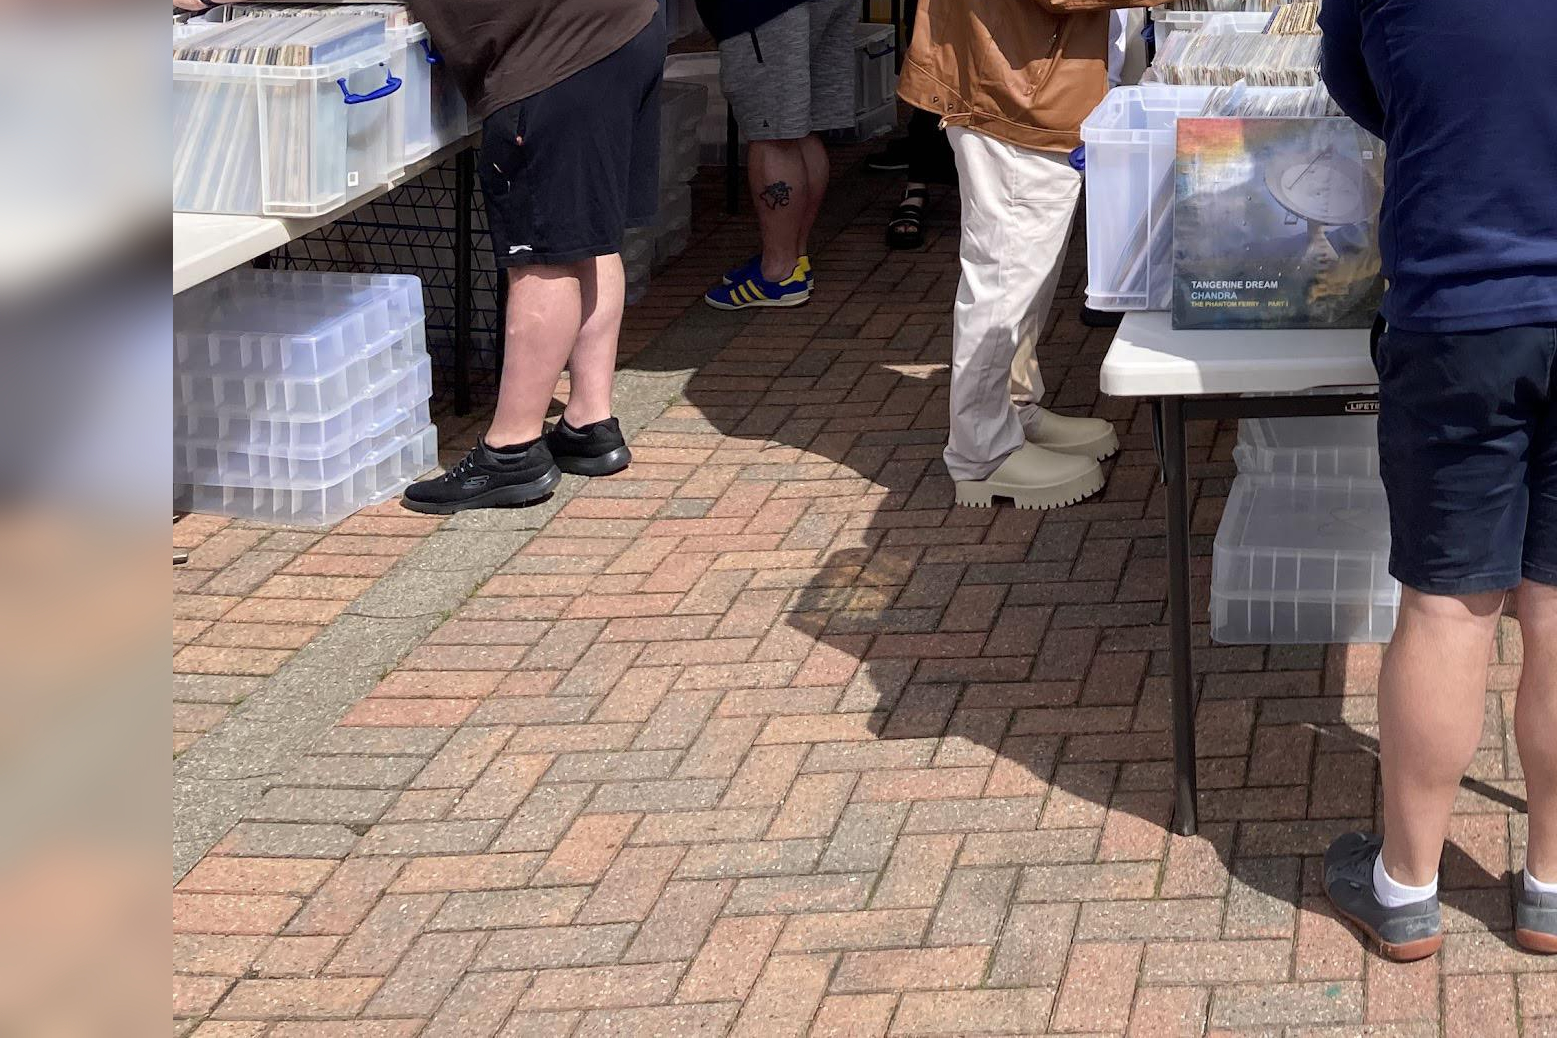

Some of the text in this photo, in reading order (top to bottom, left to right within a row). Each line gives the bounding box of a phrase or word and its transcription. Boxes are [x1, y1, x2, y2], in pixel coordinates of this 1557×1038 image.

[1190, 280, 1278, 289] TANGERINE DREAM
[1190, 291, 1238, 300] CHANDRA
